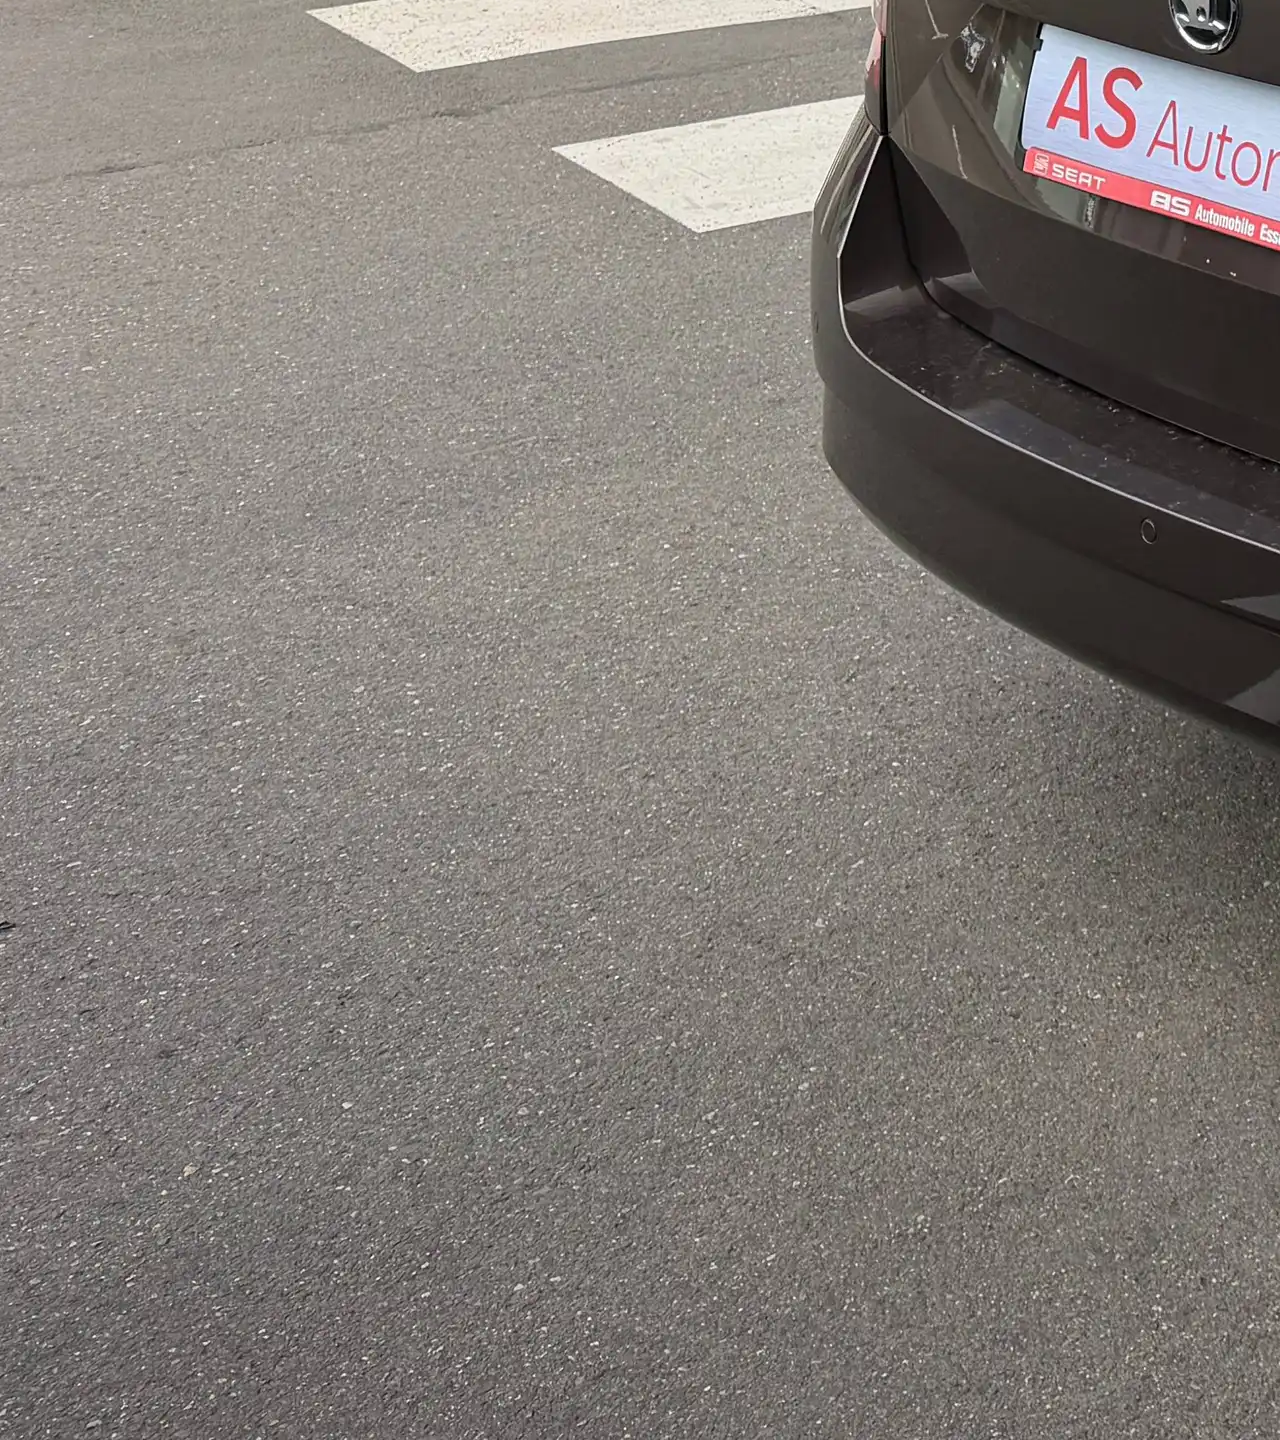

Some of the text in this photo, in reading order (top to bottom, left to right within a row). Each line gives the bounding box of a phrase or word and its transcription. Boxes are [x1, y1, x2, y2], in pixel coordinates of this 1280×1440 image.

[1046, 55, 1144, 150] AS
[1051, 162, 1106, 191] SEAT
[1194, 203, 1255, 238] Automobile
